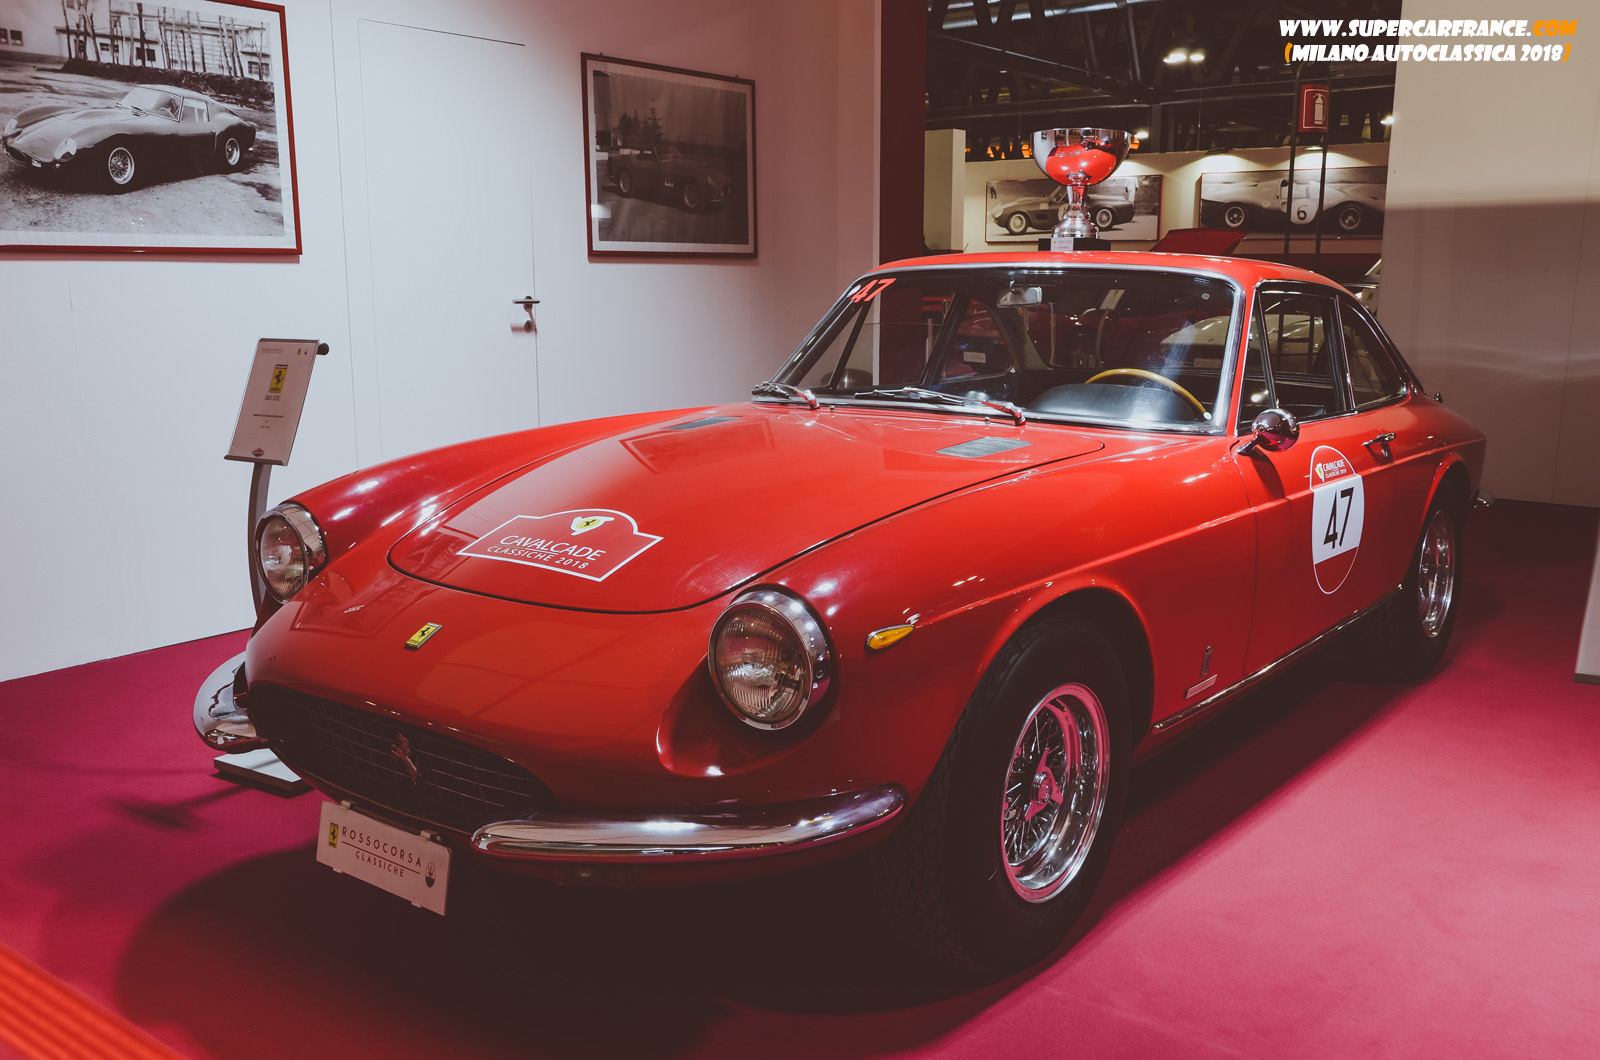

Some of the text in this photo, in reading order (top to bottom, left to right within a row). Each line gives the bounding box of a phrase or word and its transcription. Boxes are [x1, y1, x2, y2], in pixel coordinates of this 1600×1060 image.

[1297, 204, 1307, 221] 6
[851, 278, 896, 303] 47
[1323, 459, 1345, 472] CAVALCADE
[1323, 487, 1354, 549] 47
[487, 545, 589, 569] CLASSICHE 2018
[500, 535, 606, 561] CAVALCADE
[342, 826, 421, 867] ROSSOCORSA
[355, 851, 404, 878] CLASSICHE
